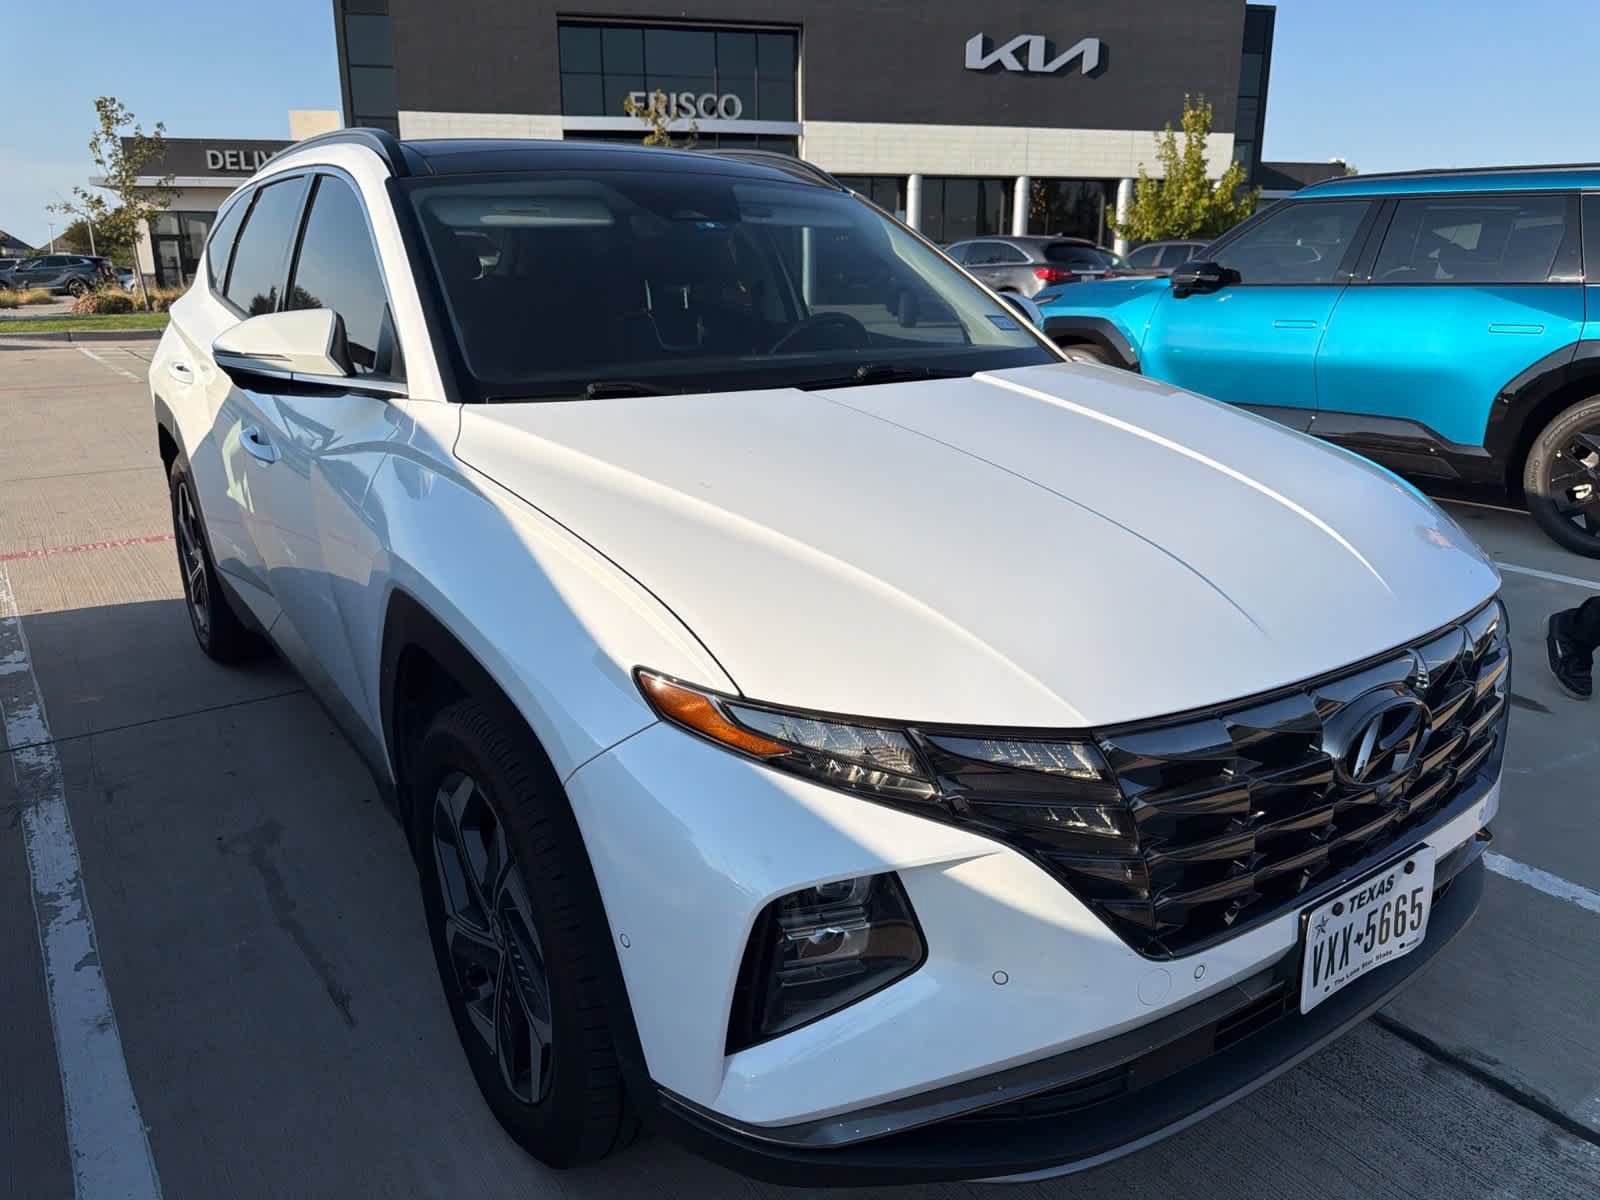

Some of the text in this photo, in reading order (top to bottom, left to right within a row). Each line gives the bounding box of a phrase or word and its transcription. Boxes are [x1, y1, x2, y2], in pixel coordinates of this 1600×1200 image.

[965, 32, 1100, 75] KIA
[627, 90, 743, 120] FRISCO
[1349, 874, 1395, 914] TEXAS
